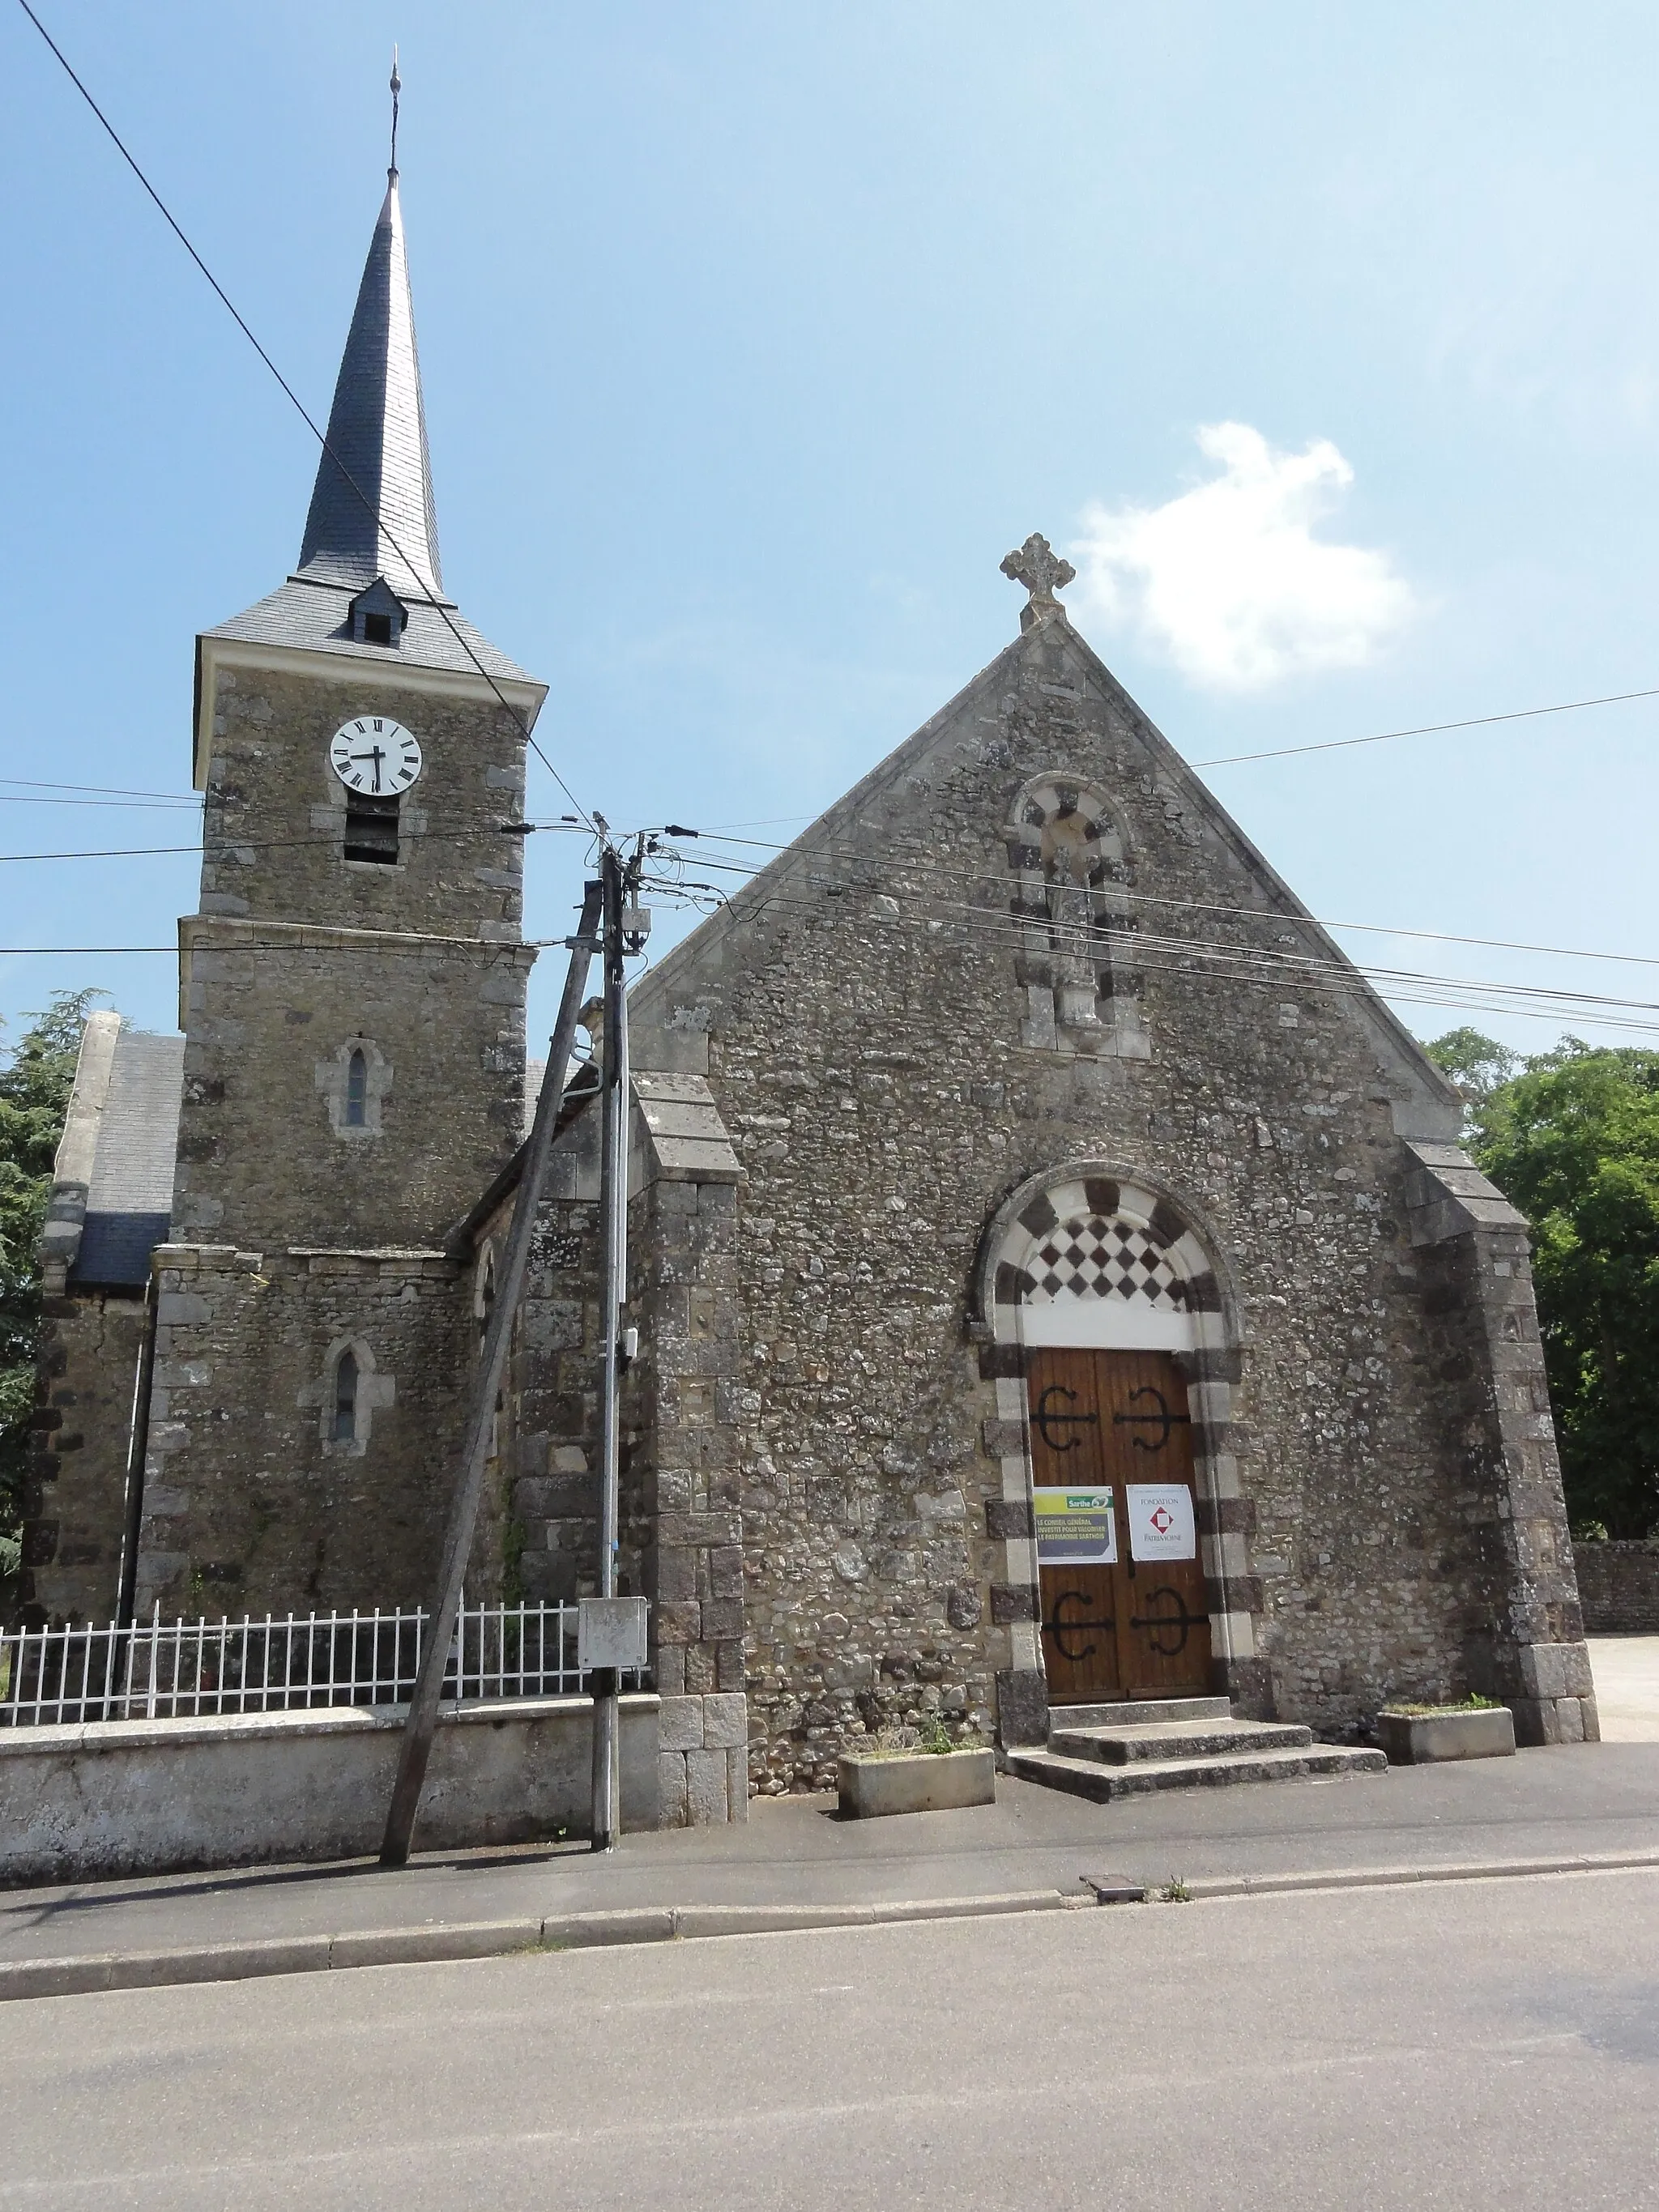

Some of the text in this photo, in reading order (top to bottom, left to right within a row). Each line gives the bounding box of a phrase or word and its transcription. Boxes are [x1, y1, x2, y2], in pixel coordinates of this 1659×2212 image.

[354, 721, 367, 735] XI
[373, 719, 383, 733] XII
[389, 726, 399, 738] I
[339, 731, 354, 744] X
[399, 739, 415, 749] II
[404, 756, 419, 764] III
[336, 761, 353, 774] VIII
[350, 772, 365, 787] VII
[1144, 1533, 1181, 1542] PATRIMOINE
